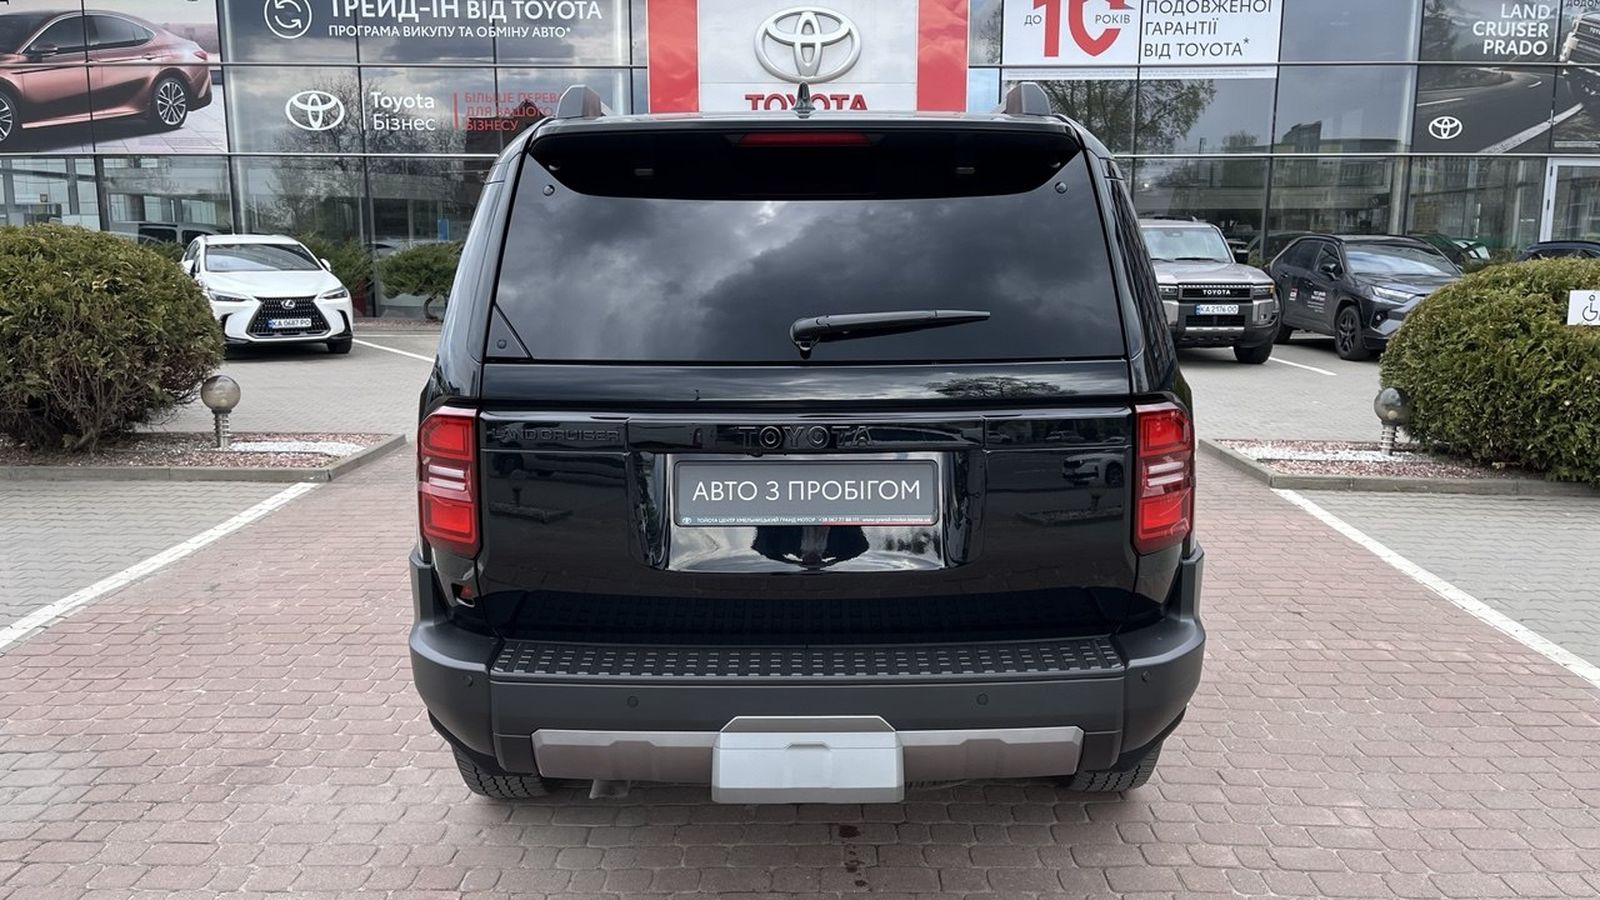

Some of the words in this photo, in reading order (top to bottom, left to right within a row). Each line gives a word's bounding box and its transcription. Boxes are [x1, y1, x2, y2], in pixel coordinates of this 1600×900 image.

[467, 0, 507, 23] ВІД
[1095, 14, 1131, 24] РОКІВ
[1501, 3, 1551, 19] LAND
[1024, 14, 1042, 26] ДО
[1145, 18, 1219, 35] ГАРАНТІЇ
[1473, 20, 1549, 37] CRUISER
[328, 25, 400, 37] ПРОГРАМА
[403, 26, 455, 38] ВИКУПУ
[458, 26, 474, 37] ТА
[476, 26, 529, 38] ОБМІНУ
[1144, 43, 1171, 60] ВІД
[1483, 40, 1548, 56] PRADO
[371, 92, 435, 113] Toyota
[373, 114, 436, 132] Бізнес
[464, 119, 519, 131] БІЗНЕСУ
[541, 429, 620, 442] CRUISER
[738, 425, 873, 449] TOYOTA
[692, 481, 758, 501] АВТО
[766, 480, 781, 501] З
[788, 480, 921, 501] ПРОБІГОМ
